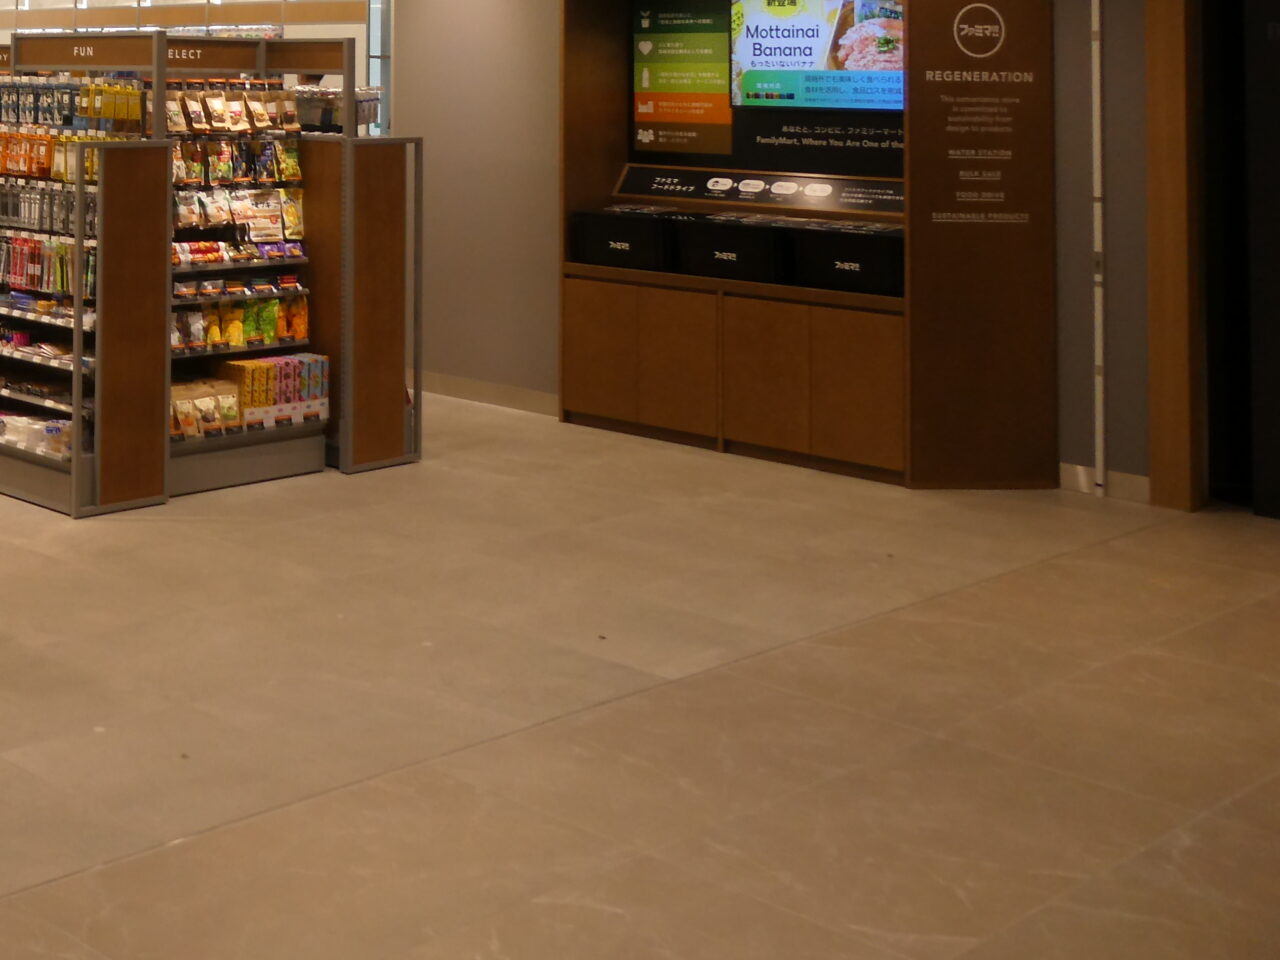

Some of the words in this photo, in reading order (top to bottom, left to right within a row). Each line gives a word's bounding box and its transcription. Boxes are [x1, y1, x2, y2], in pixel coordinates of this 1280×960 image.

[745, 24, 820, 40] Mottainai
[73, 46, 95, 57] FUN
[167, 49, 203, 60] ELECT
[752, 42, 814, 57] Banana
[750, 60, 816, 69] もったいないバナナ
[925, 70, 1034, 83] REGENERATION
